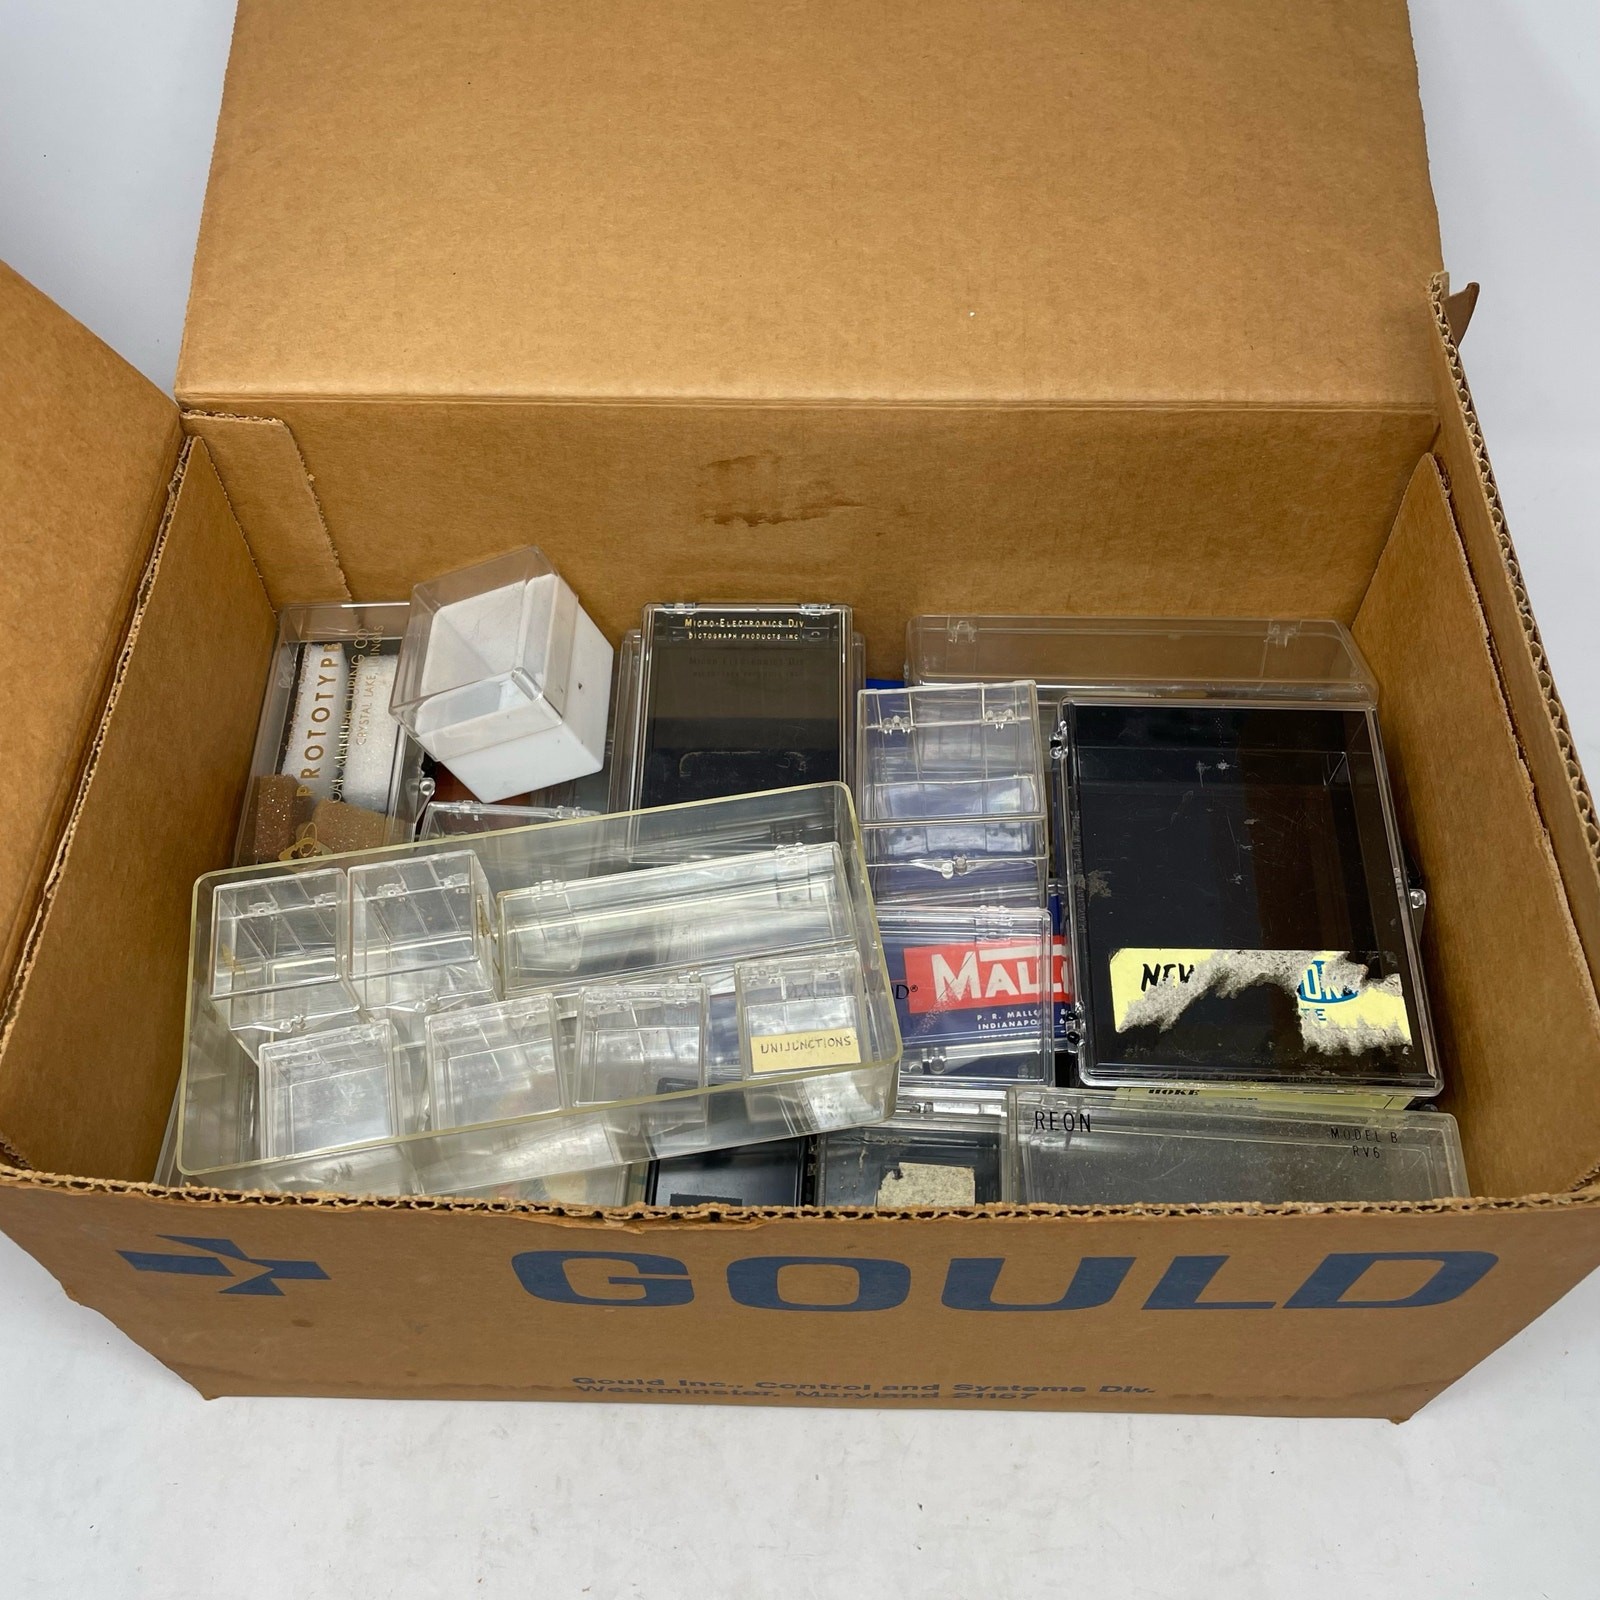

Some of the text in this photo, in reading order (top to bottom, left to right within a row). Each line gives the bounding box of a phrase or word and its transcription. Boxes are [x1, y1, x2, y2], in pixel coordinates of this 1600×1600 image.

[741, 632, 781, 640] PRODUCTS
[296, 642, 342, 797] PROTOTYPE
[356, 702, 373, 746] CRYSTAL
[931, 945, 1069, 1001] MALL
[760, 1035, 852, 1054] UNIJUNCTIONS
[1034, 1110, 1091, 1133] REON
[1330, 1127, 1398, 1144] MODEL B
[1352, 1145, 1380, 1159] RV6
[510, 1250, 1499, 1312] GOULD
[572, 1377, 664, 1386] Gould
[755, 1381, 870, 1391] Control
[952, 1384, 1086, 1393] Systems
[1099, 1385, 1155, 1393] Div.
[795, 1391, 939, 1399] Maryland
[952, 1392, 1037, 1400] 21167
